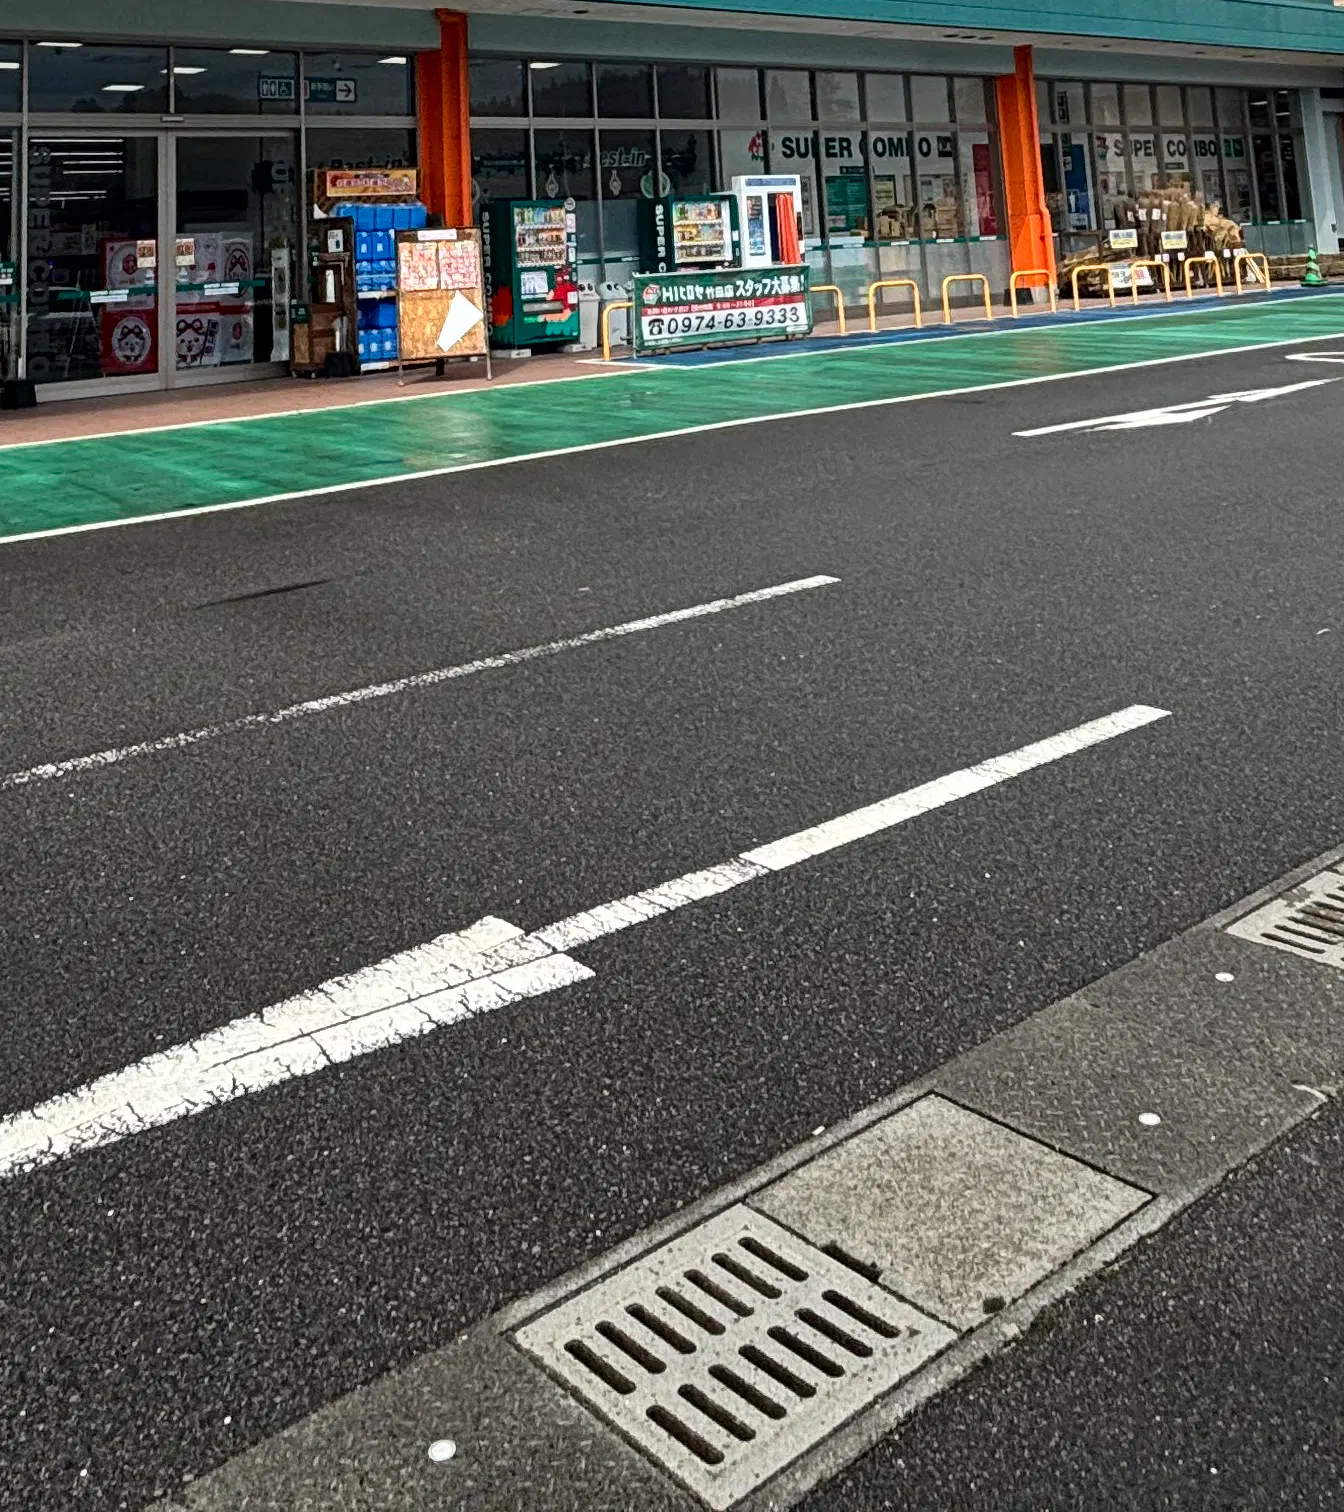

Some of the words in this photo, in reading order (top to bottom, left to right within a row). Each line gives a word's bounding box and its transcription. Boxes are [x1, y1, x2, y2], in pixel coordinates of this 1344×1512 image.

[781, 136, 853, 159] SUER
[859, 136, 932, 159] OMO
[1113, 138, 1158, 157] SPE
[1166, 138, 1218, 157] COBO
[481, 211, 491, 268] SUPER
[655, 204, 666, 258] SUPER
[667, 306, 800, 335] 0974-63-9333
